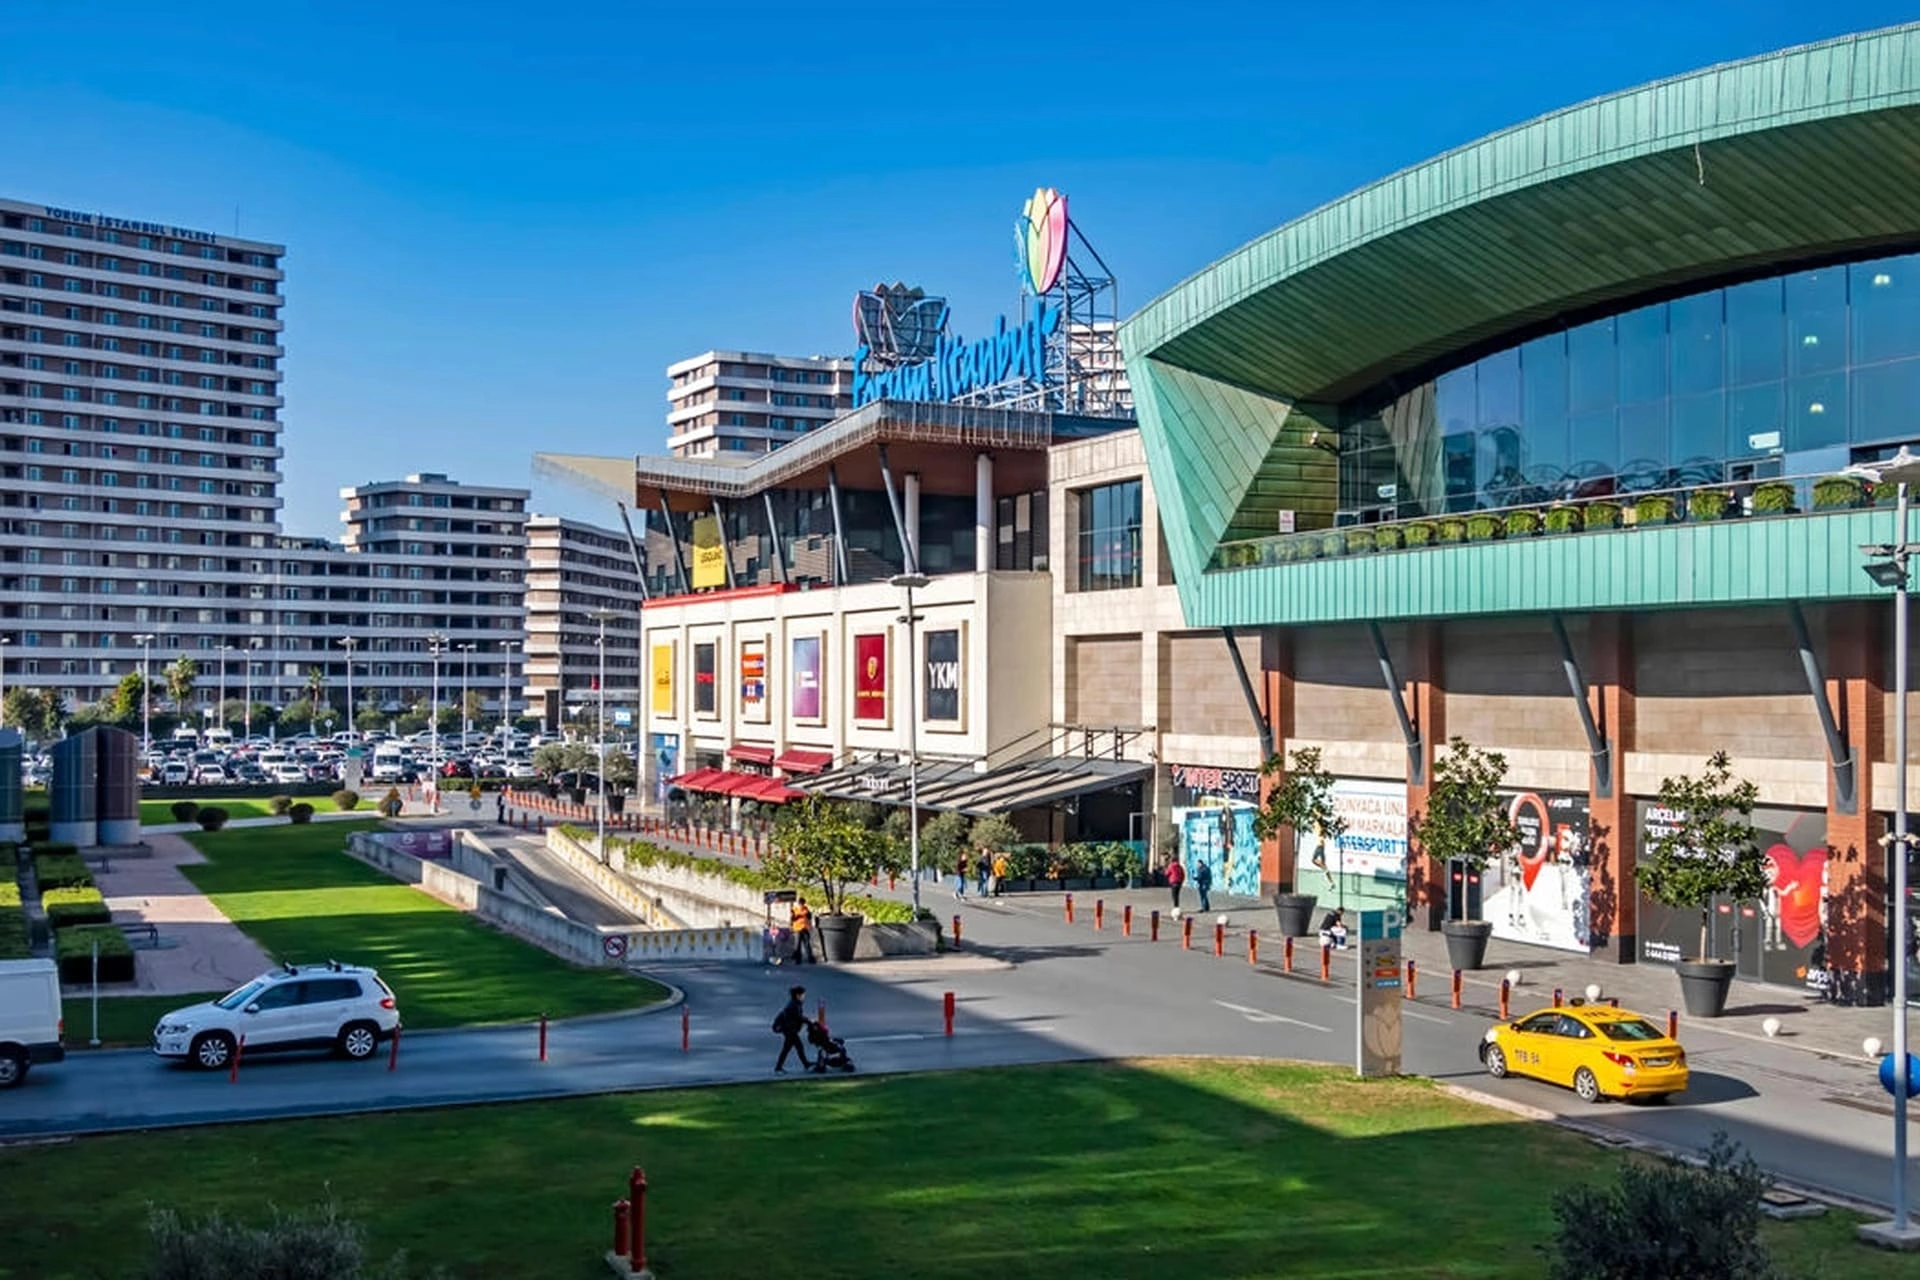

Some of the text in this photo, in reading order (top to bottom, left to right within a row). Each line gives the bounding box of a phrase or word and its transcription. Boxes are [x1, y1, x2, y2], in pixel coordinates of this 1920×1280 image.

[853, 344, 931, 409] Forum
[928, 661, 958, 690] YKM
[1184, 767, 1260, 793] INTERSPORT
[1382, 910, 1401, 939] P
